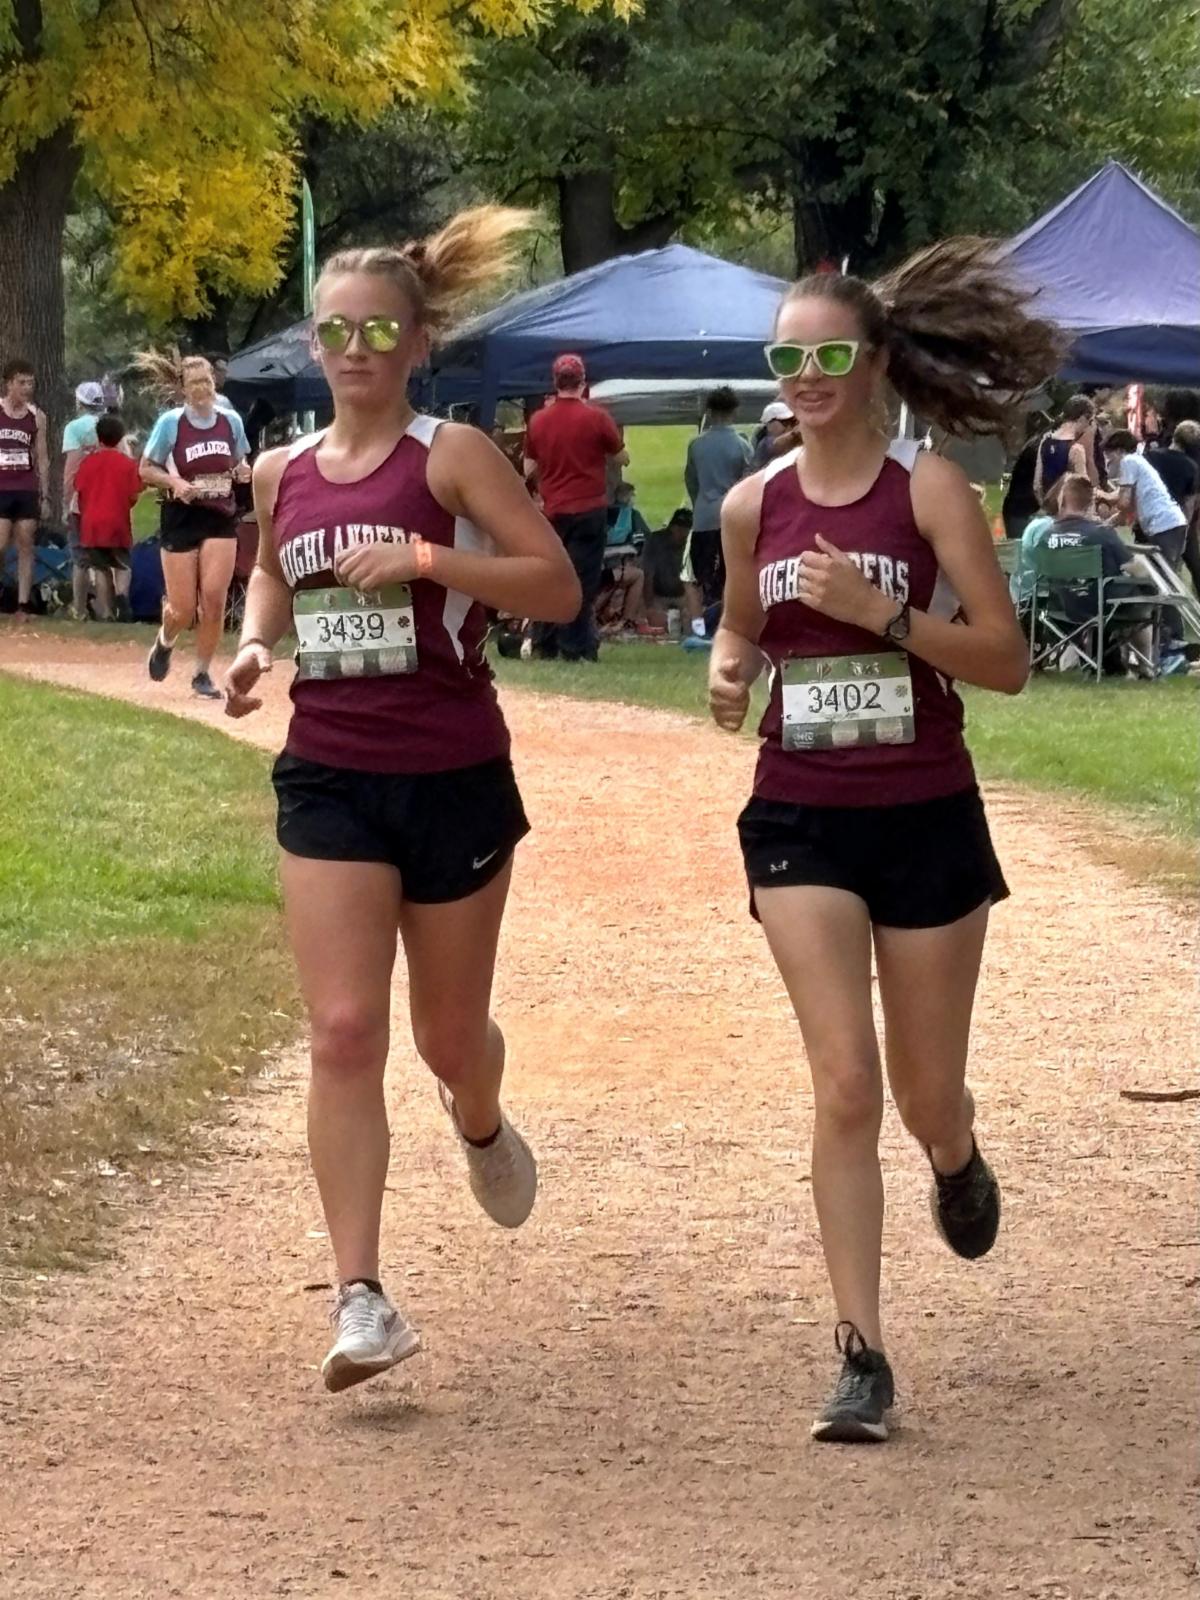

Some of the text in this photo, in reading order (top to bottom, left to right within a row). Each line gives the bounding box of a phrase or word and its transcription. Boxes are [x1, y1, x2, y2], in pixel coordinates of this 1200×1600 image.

[759, 552, 909, 612] HIGHERS
[317, 613, 385, 643] 3439
[808, 682, 882, 713] 3402
